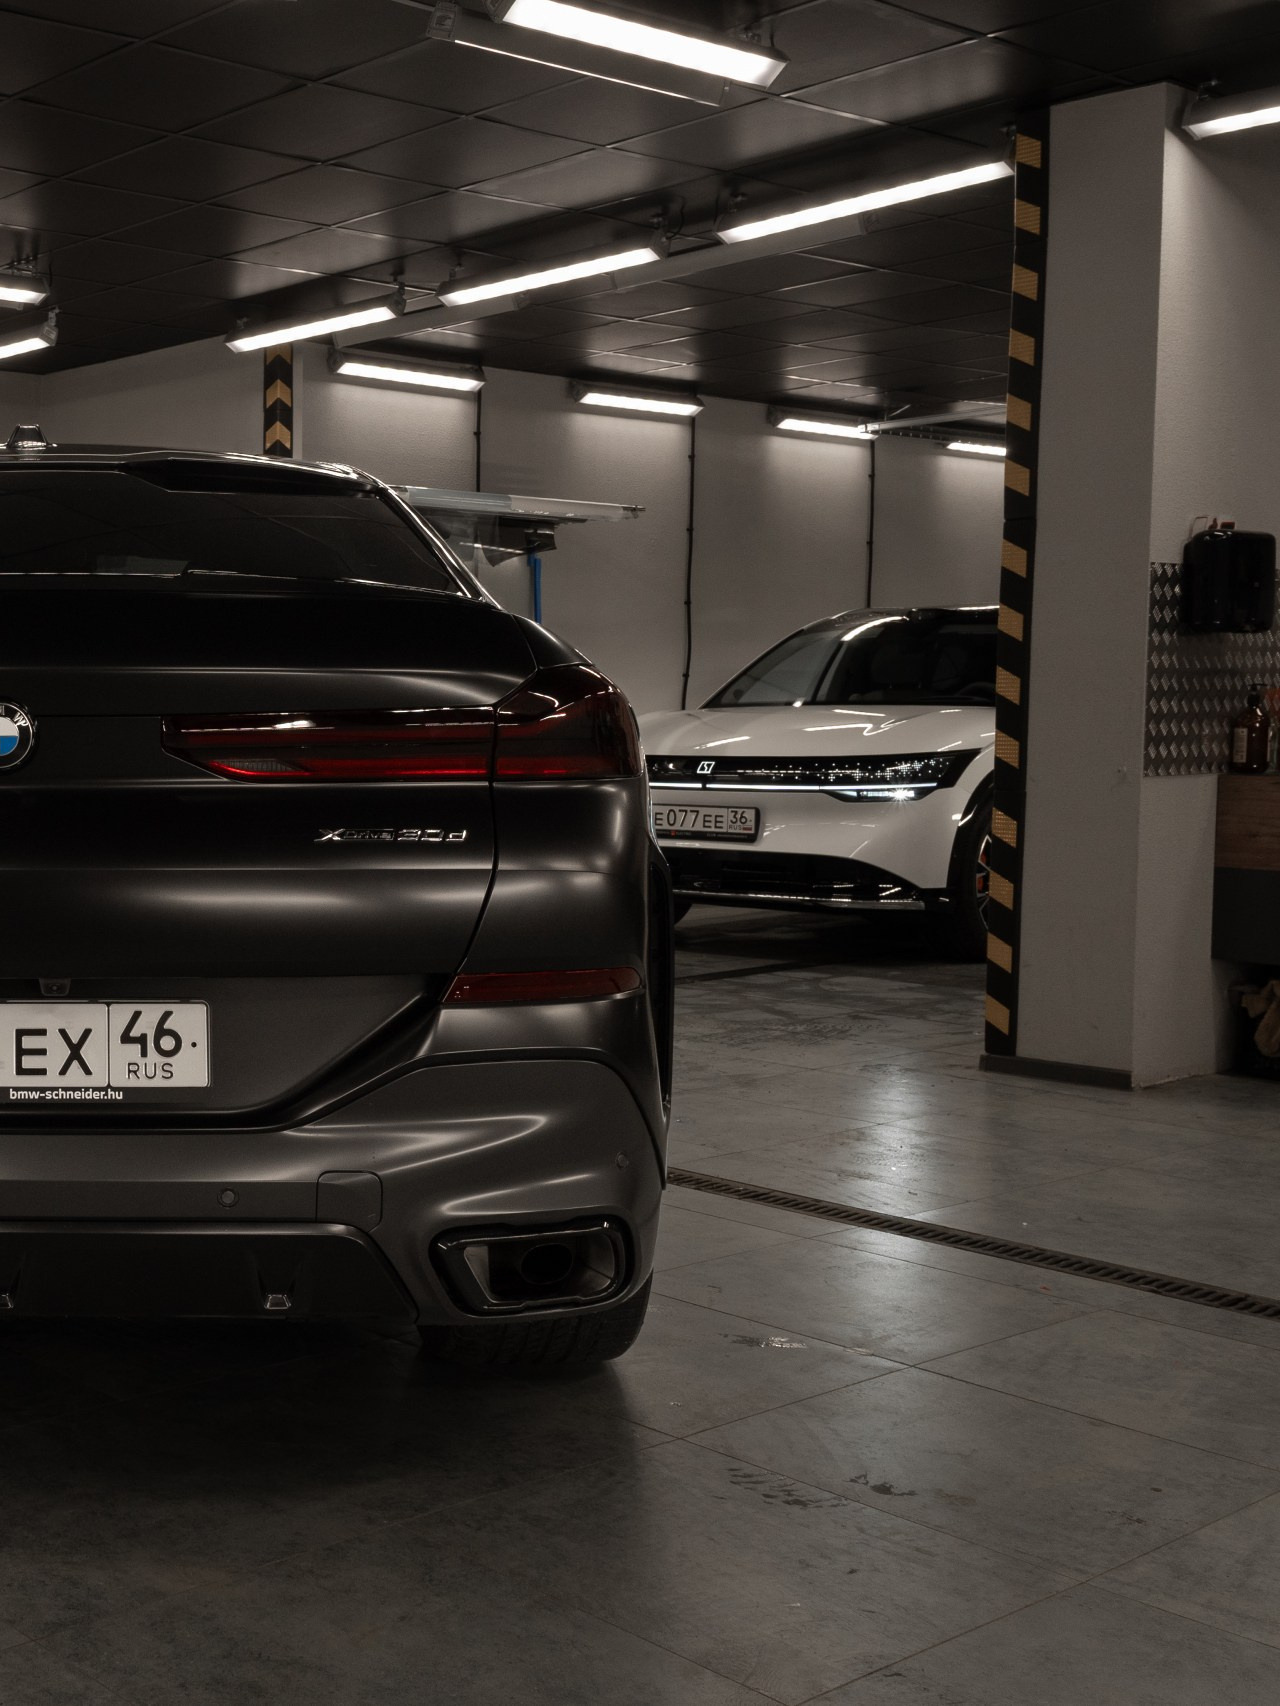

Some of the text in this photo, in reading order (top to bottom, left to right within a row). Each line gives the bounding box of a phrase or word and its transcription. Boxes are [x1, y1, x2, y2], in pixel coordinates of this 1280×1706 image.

[730, 810, 748, 825] 36
[120, 1010, 183, 1058] 46
[127, 1063, 174, 1080] RUS
[9, 1088, 123, 1099] bmw-schneider.hu
